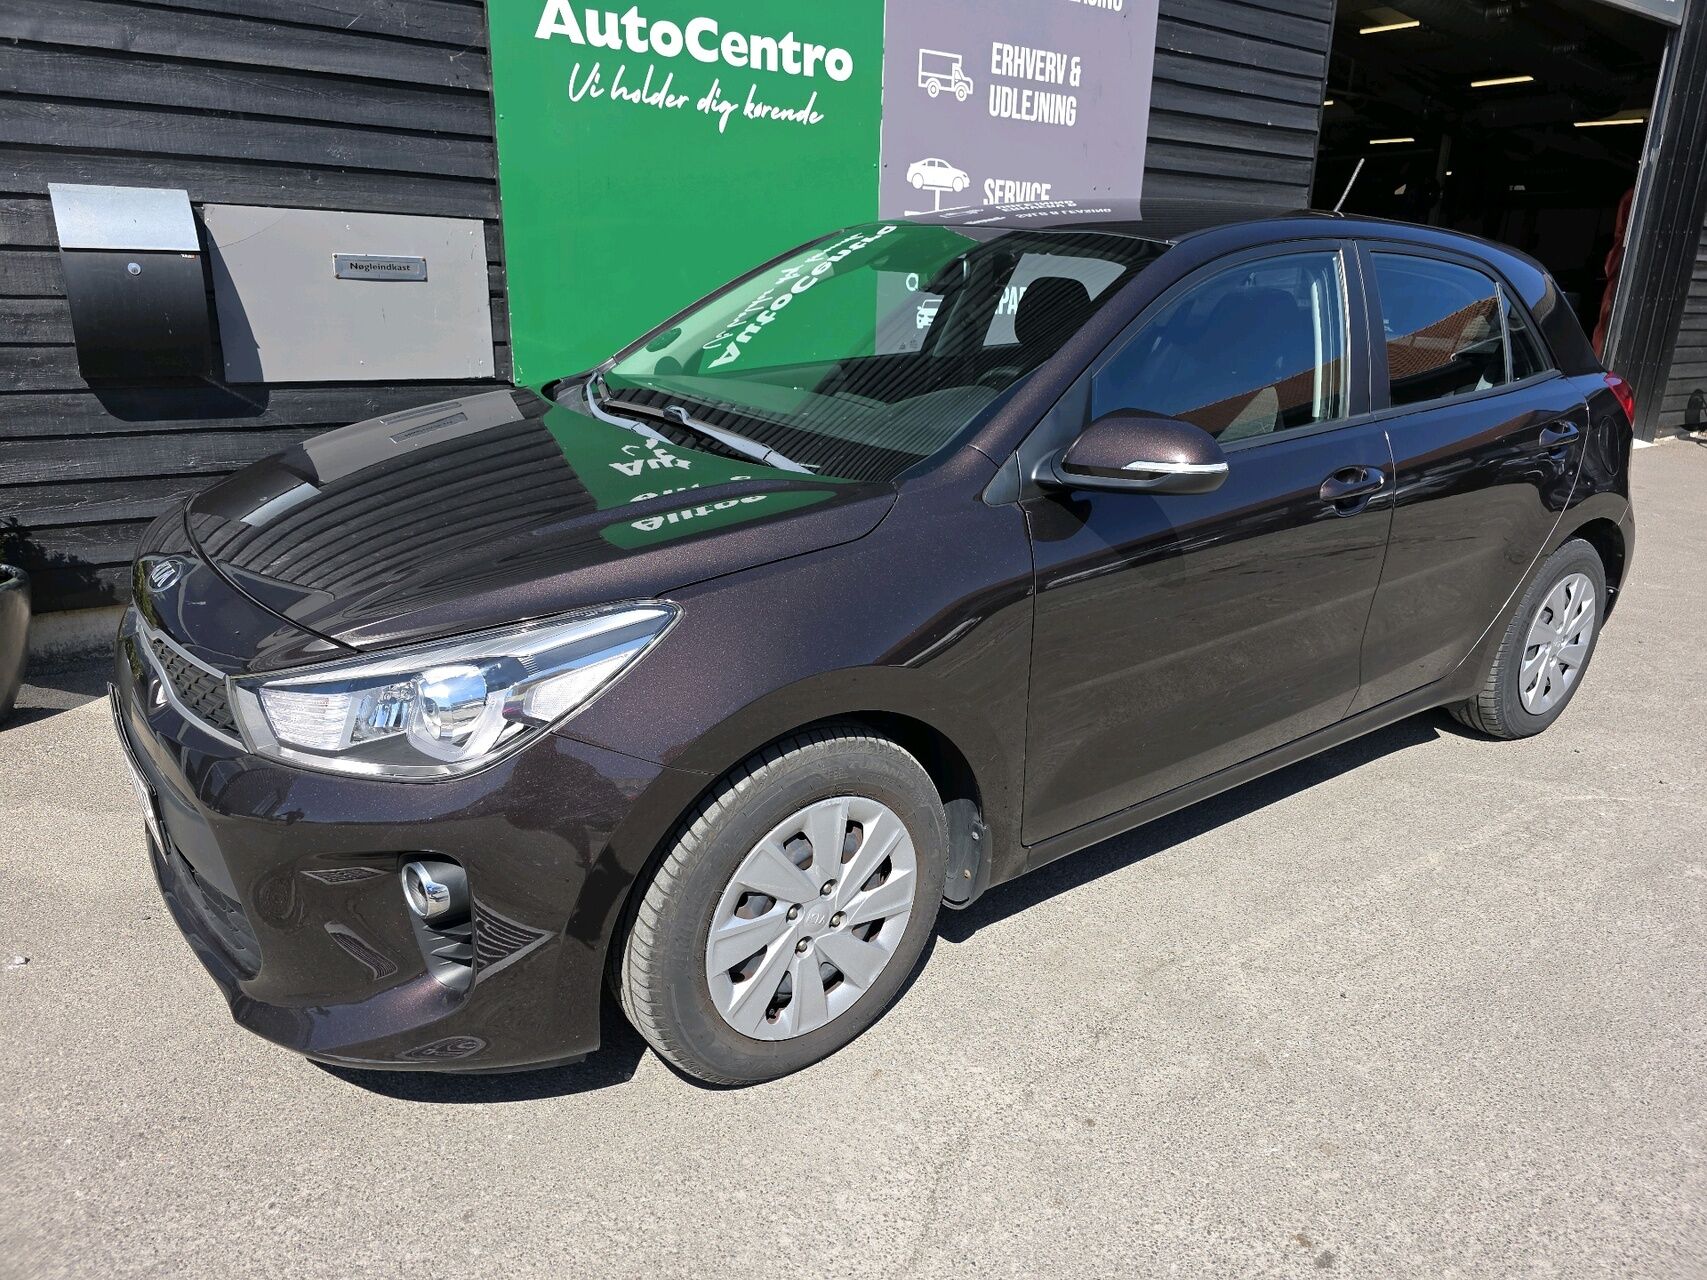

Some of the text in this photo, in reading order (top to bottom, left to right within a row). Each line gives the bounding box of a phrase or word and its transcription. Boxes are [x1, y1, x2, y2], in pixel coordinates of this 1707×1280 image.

[535, 0, 854, 82] AutoCentro
[991, 41, 1081, 87] ERHVERV &
[568, 62, 824, 133] Vi holder dig kørende
[989, 84, 1077, 127] UDLEJNING
[983, 178, 1052, 205] SERVICE
[349, 262, 411, 273] Nøgleindkast
